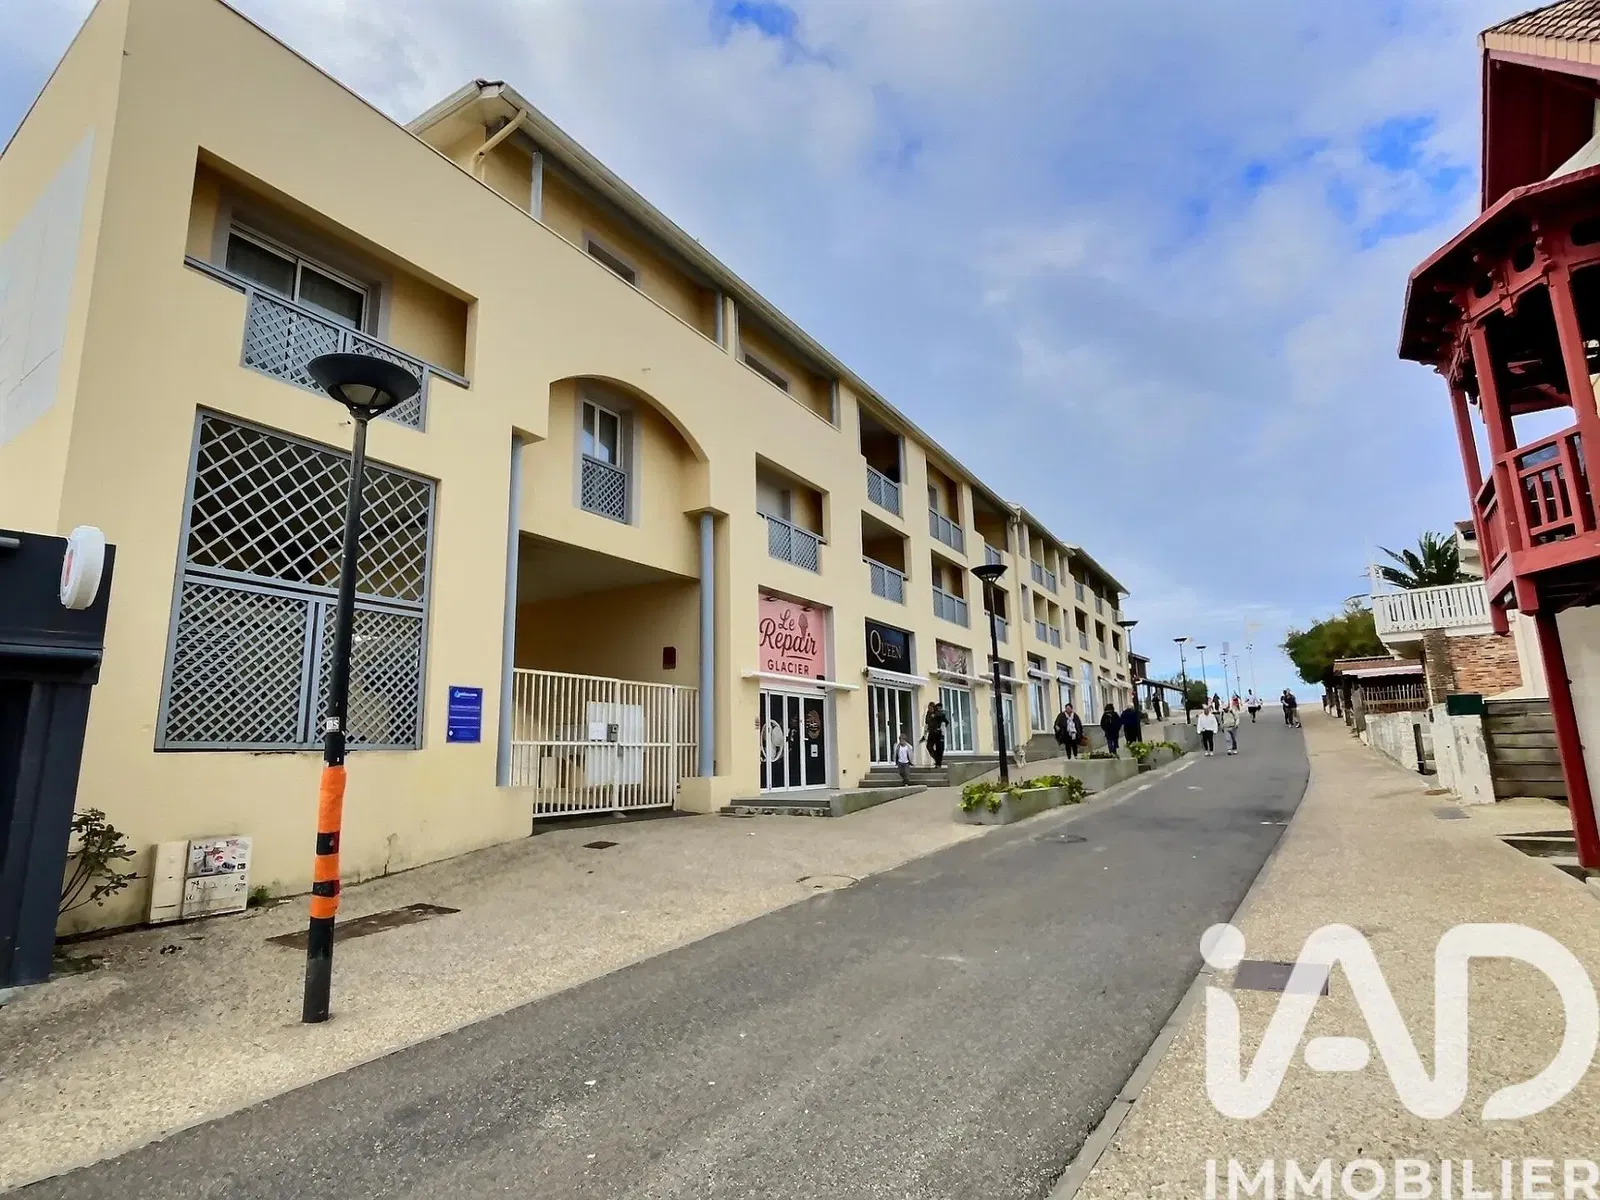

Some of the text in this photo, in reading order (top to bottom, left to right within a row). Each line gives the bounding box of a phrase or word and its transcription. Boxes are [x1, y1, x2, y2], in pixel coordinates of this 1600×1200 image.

[778, 609, 795, 631] Le
[759, 618, 817, 656] Repair
[870, 629, 902, 663] QUEEN
[767, 659, 810, 675] GLACIER
